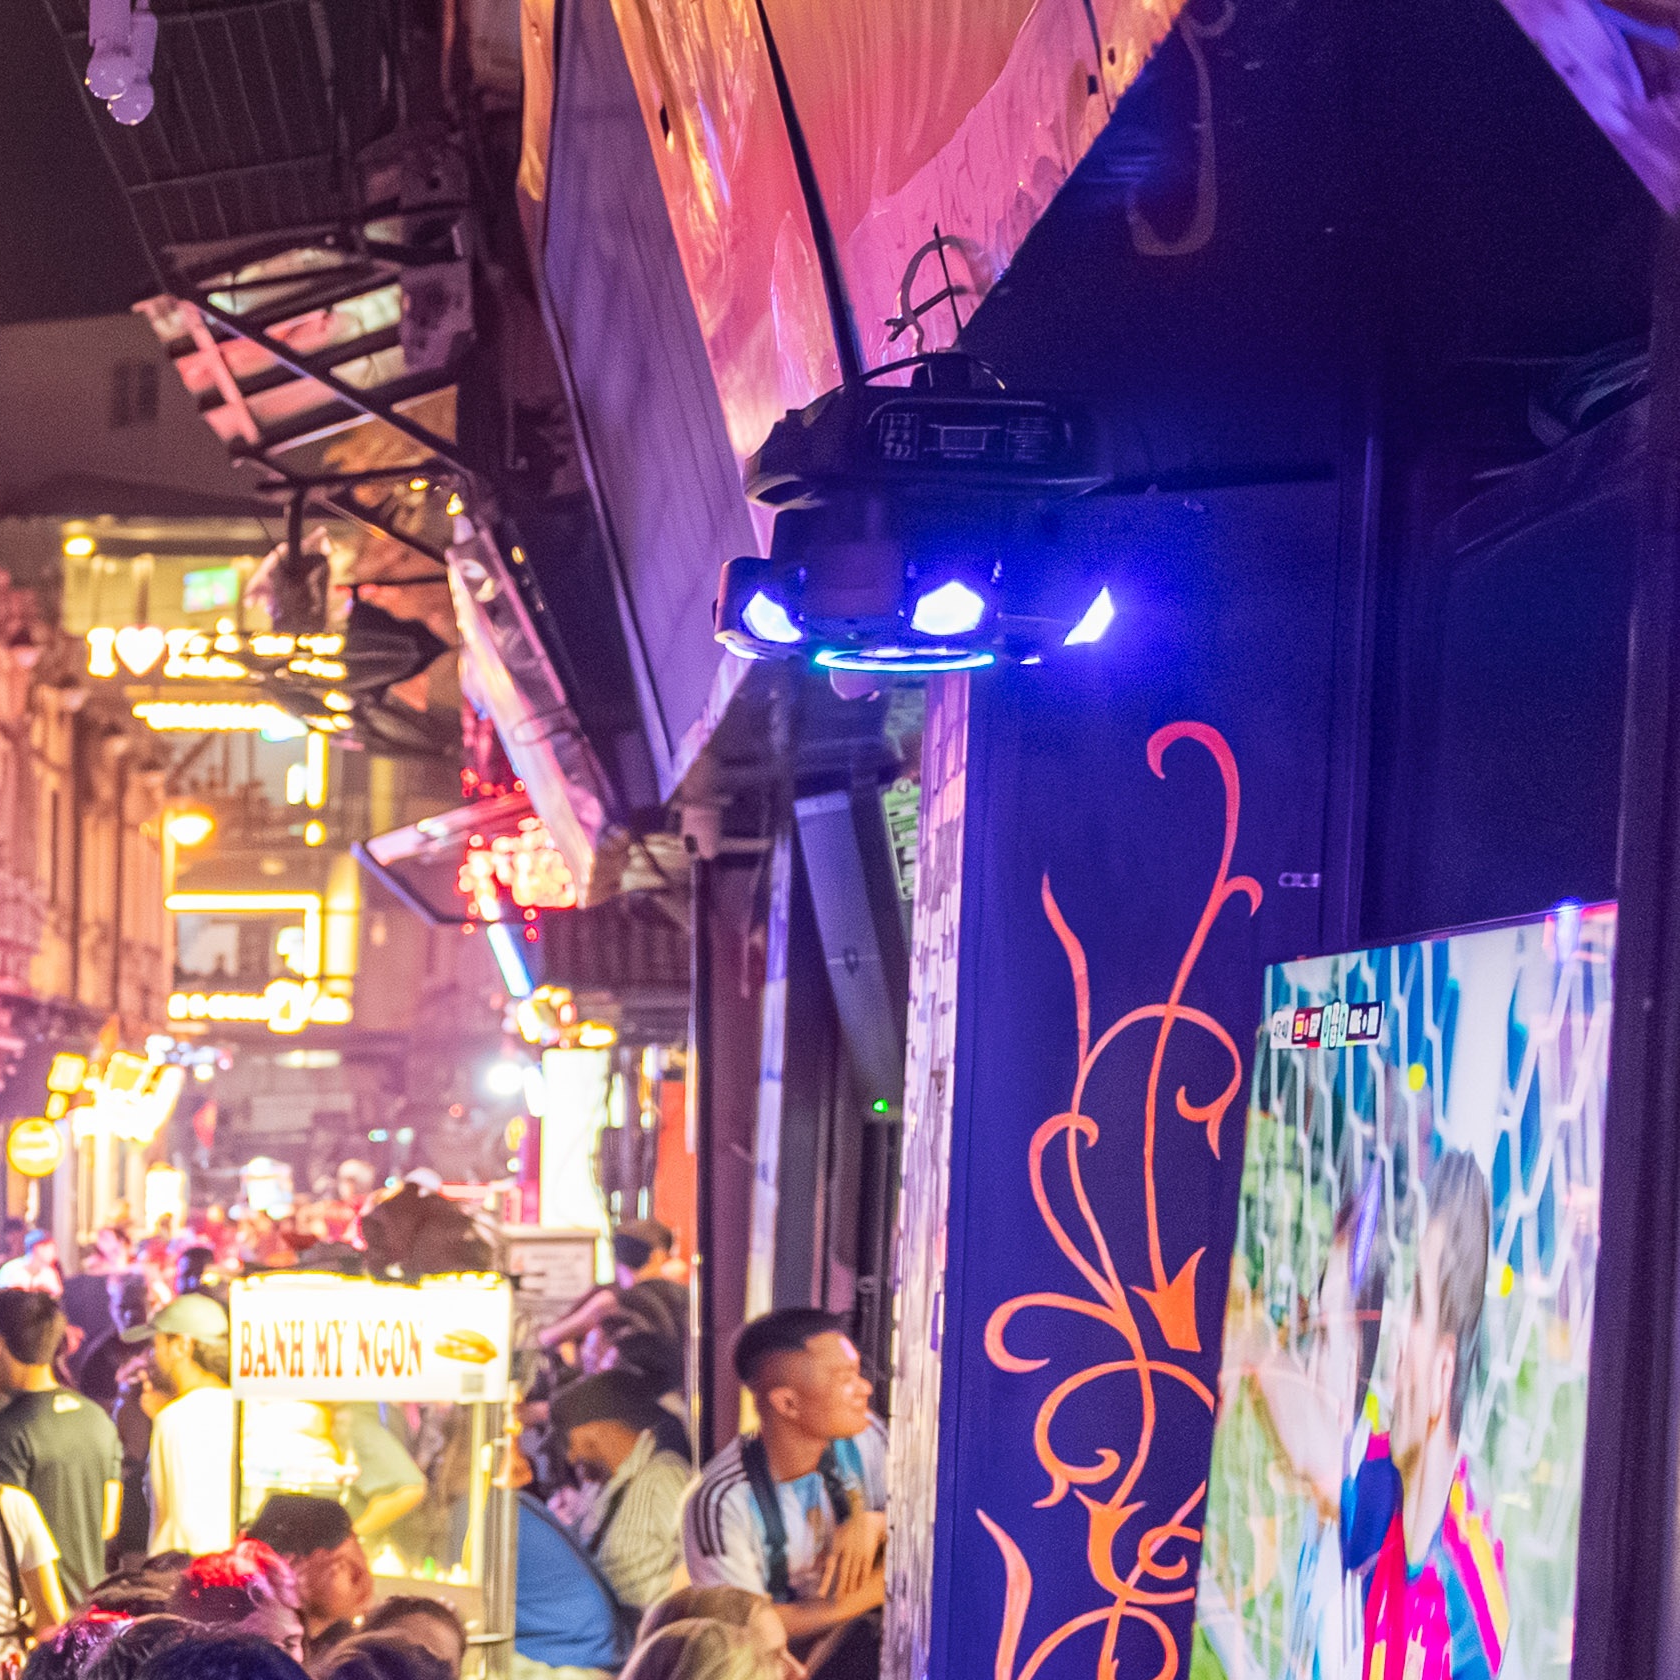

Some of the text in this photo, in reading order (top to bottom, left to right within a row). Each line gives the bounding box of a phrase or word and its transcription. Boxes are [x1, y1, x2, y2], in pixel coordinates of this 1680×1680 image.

[239, 1320, 423, 1378] BANH MY NGON
